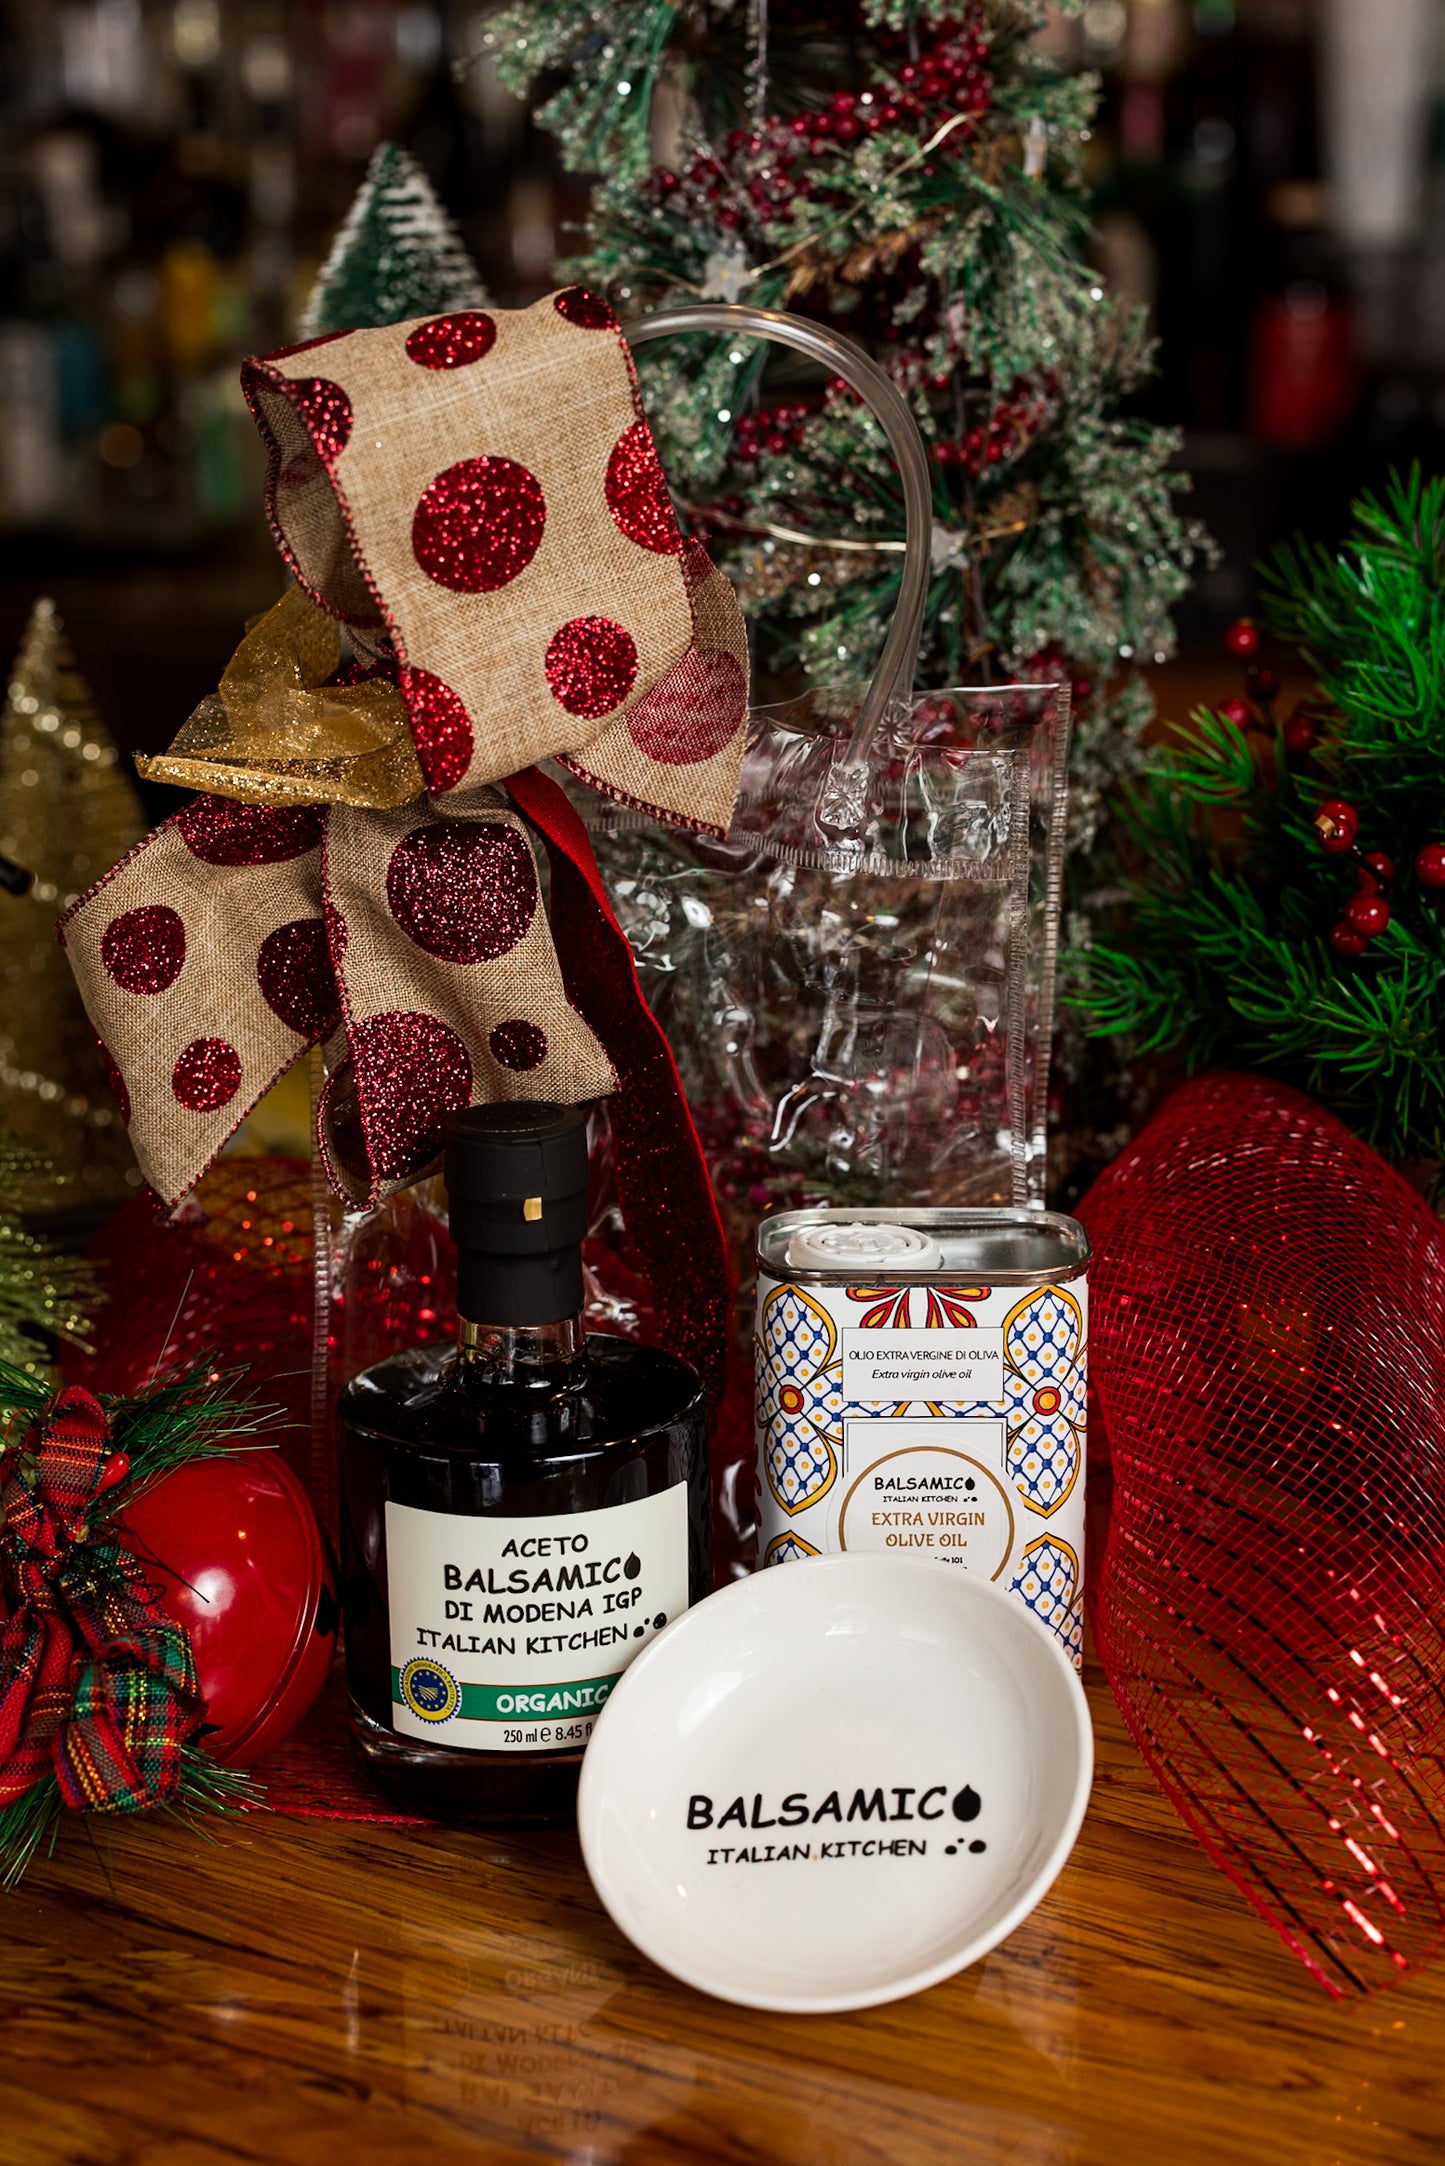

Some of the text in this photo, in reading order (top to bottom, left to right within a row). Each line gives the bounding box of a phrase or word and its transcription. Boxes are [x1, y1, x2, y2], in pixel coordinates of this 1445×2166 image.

[848, 1350, 999, 1360] OLIO EXTRA VERGINE DI OLIVA
[872, 1369, 972, 1381] Extra virgin olive oil
[883, 1495, 958, 1503] ITALIAN KITCHEN
[872, 1512, 985, 1526] EXTRA VIRGIN
[501, 1533, 588, 1558] ACETO
[885, 1533, 967, 1547] OLIVE OIL
[951, 1556, 963, 1564] 101
[445, 1586, 642, 1625] DI MODENA IGP
[416, 1623, 628, 1655] ITALIAN KITCHEN
[496, 1684, 608, 1713] ORGANIC
[503, 1729, 523, 1743] 250
[525, 1728, 538, 1742] ml
[555, 1724, 582, 1741] 8.45
[706, 1839, 926, 1864] ITALIAN KITCHEN
